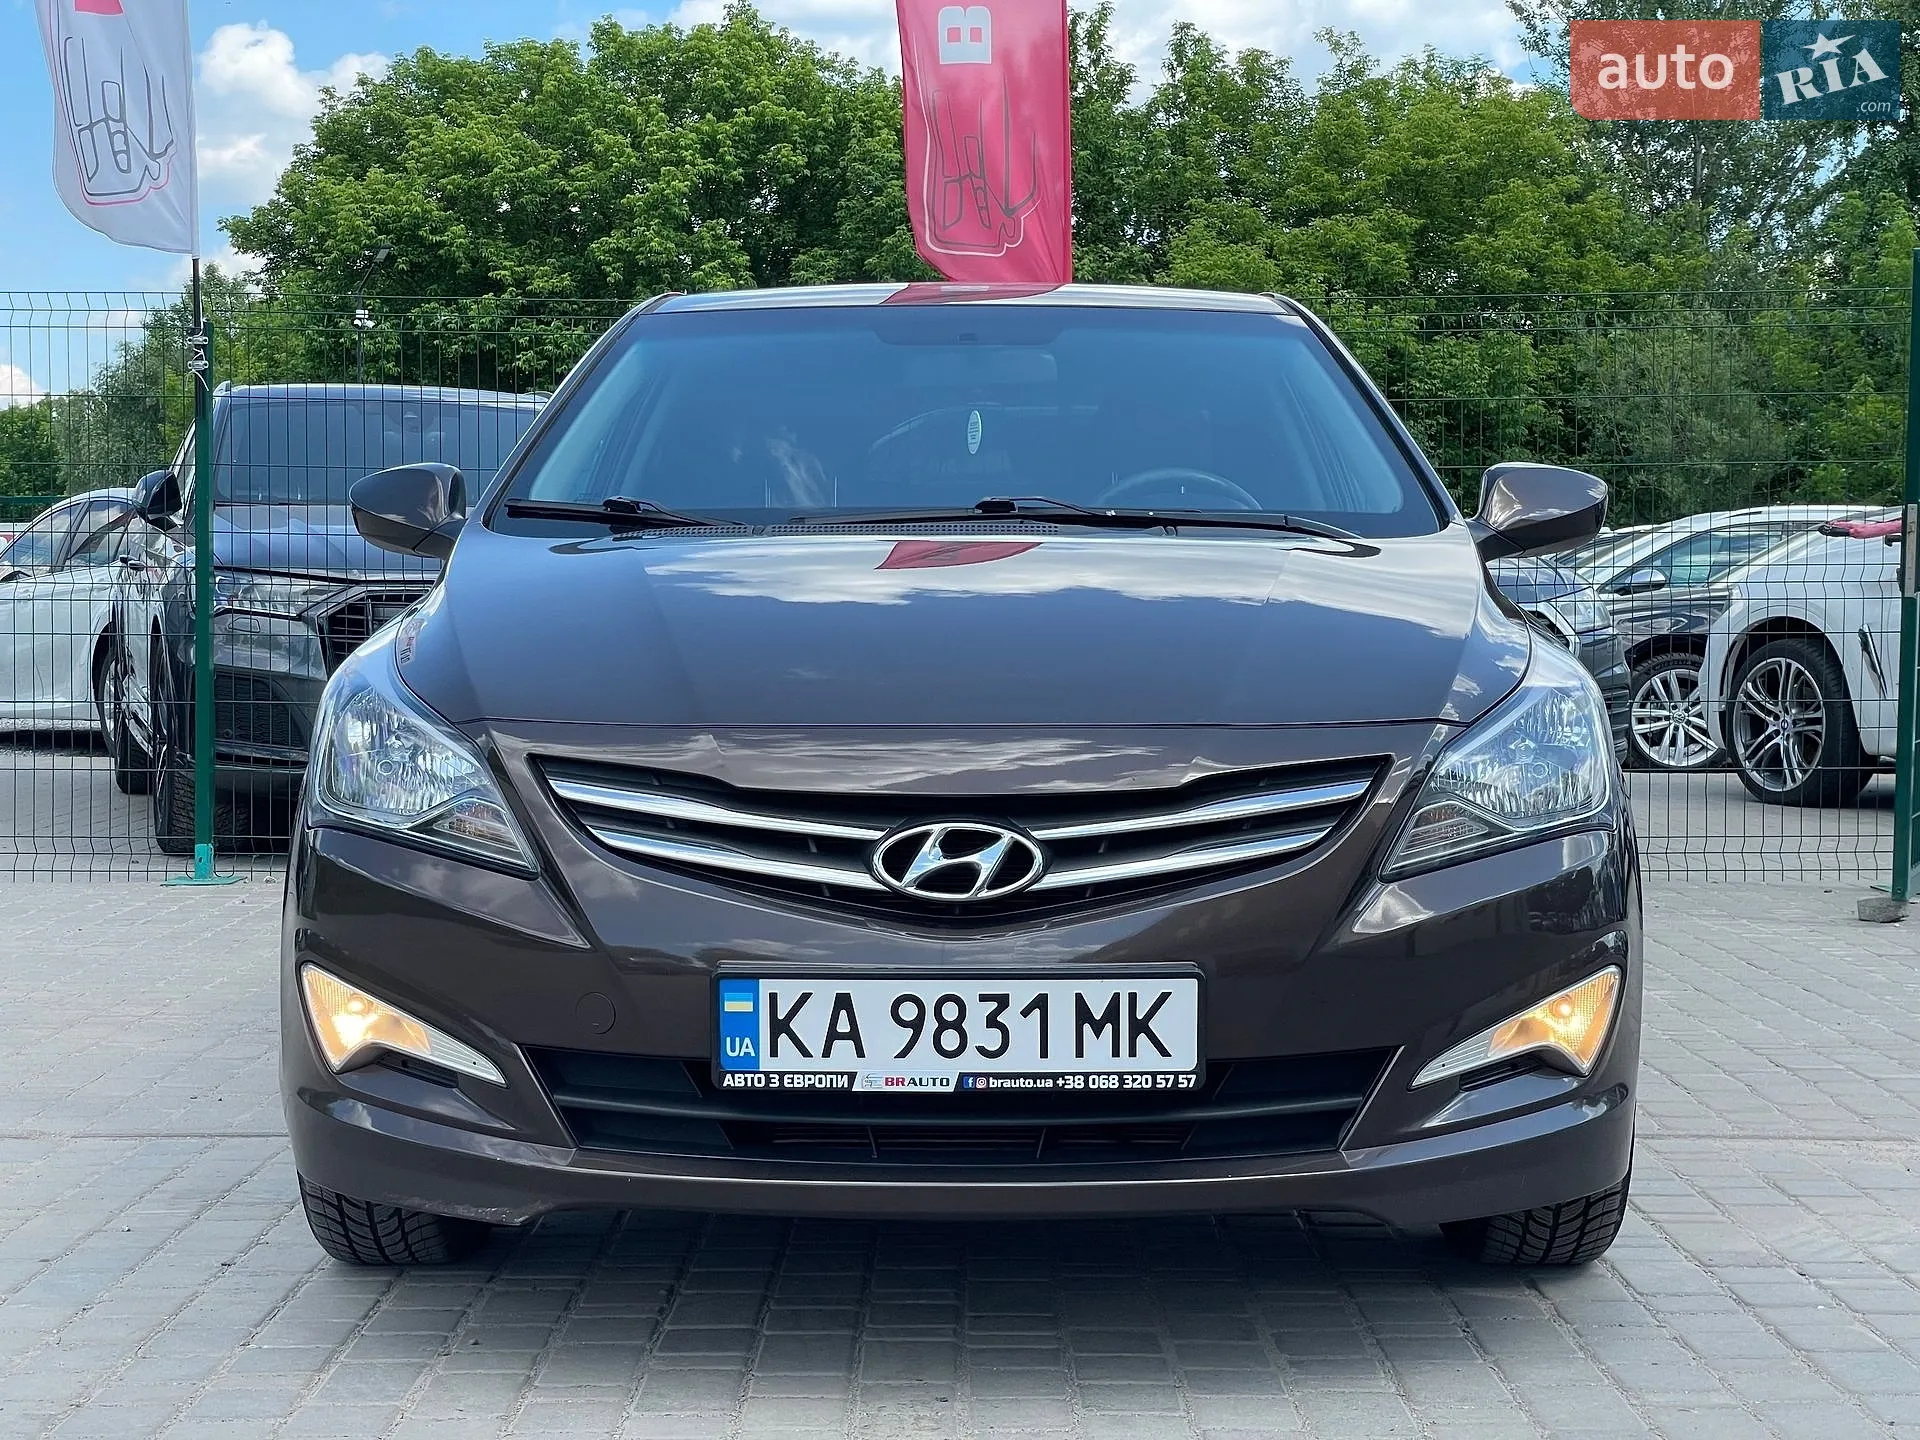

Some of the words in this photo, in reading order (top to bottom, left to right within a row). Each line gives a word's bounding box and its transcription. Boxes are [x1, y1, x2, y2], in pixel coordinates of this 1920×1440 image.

[768, 992, 866, 1059] KA
[889, 993, 1049, 1060] 9831
[1074, 991, 1173, 1059] MK
[726, 1036, 756, 1058] UA
[722, 1074, 766, 1088] АВТО
[783, 1074, 849, 1089] ЄВРОПИ
[884, 1076, 950, 1087] BRAUTO
[989, 1076, 1054, 1088] brauto.ua
[1056, 1075, 1085, 1089] +38
[1088, 1075, 1119, 1089] 068
[1122, 1075, 1152, 1089] 320
[1156, 1074, 1174, 1088] 57
[1177, 1074, 1197, 1088] 57
